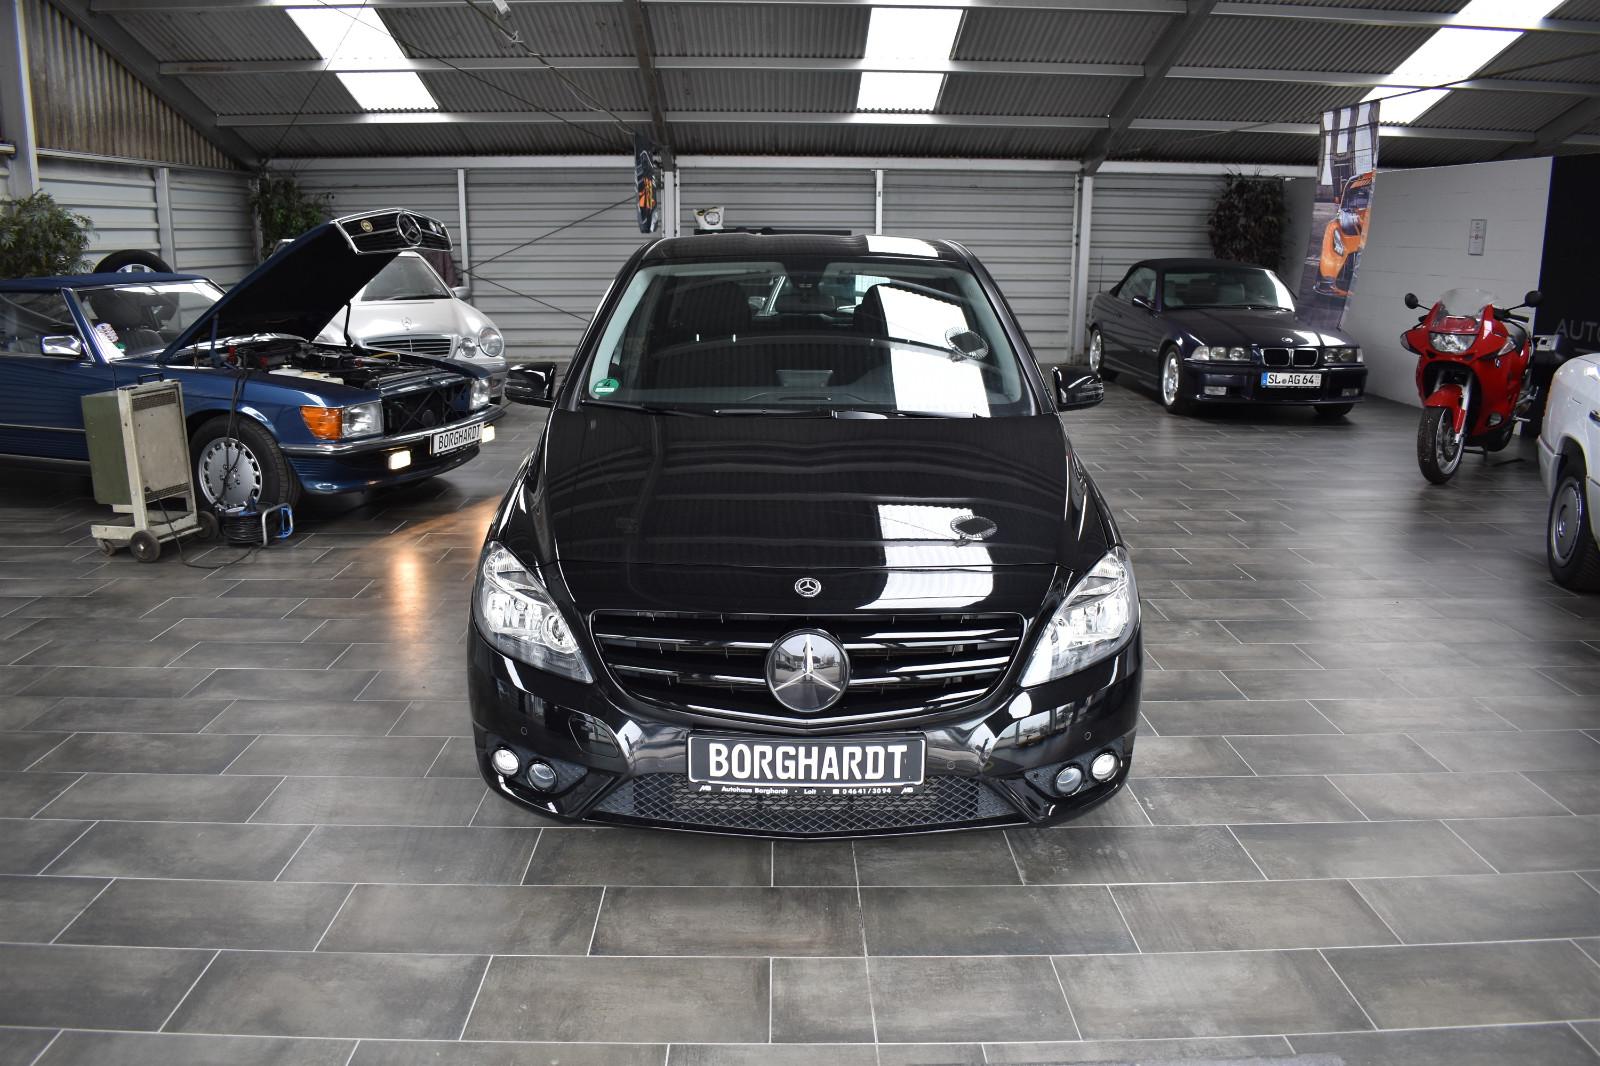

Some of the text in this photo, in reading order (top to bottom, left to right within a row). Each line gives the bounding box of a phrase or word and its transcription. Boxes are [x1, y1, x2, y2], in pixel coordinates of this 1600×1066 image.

[1555, 318, 1600, 342] AUT
[1268, 374, 1280, 384] SL
[1288, 374, 1300, 385] AG
[1302, 374, 1314, 385] 64
[438, 424, 481, 450] BORGHARDT
[709, 743, 907, 780] BORGHARDT
[754, 787, 788, 795] Borghardt
